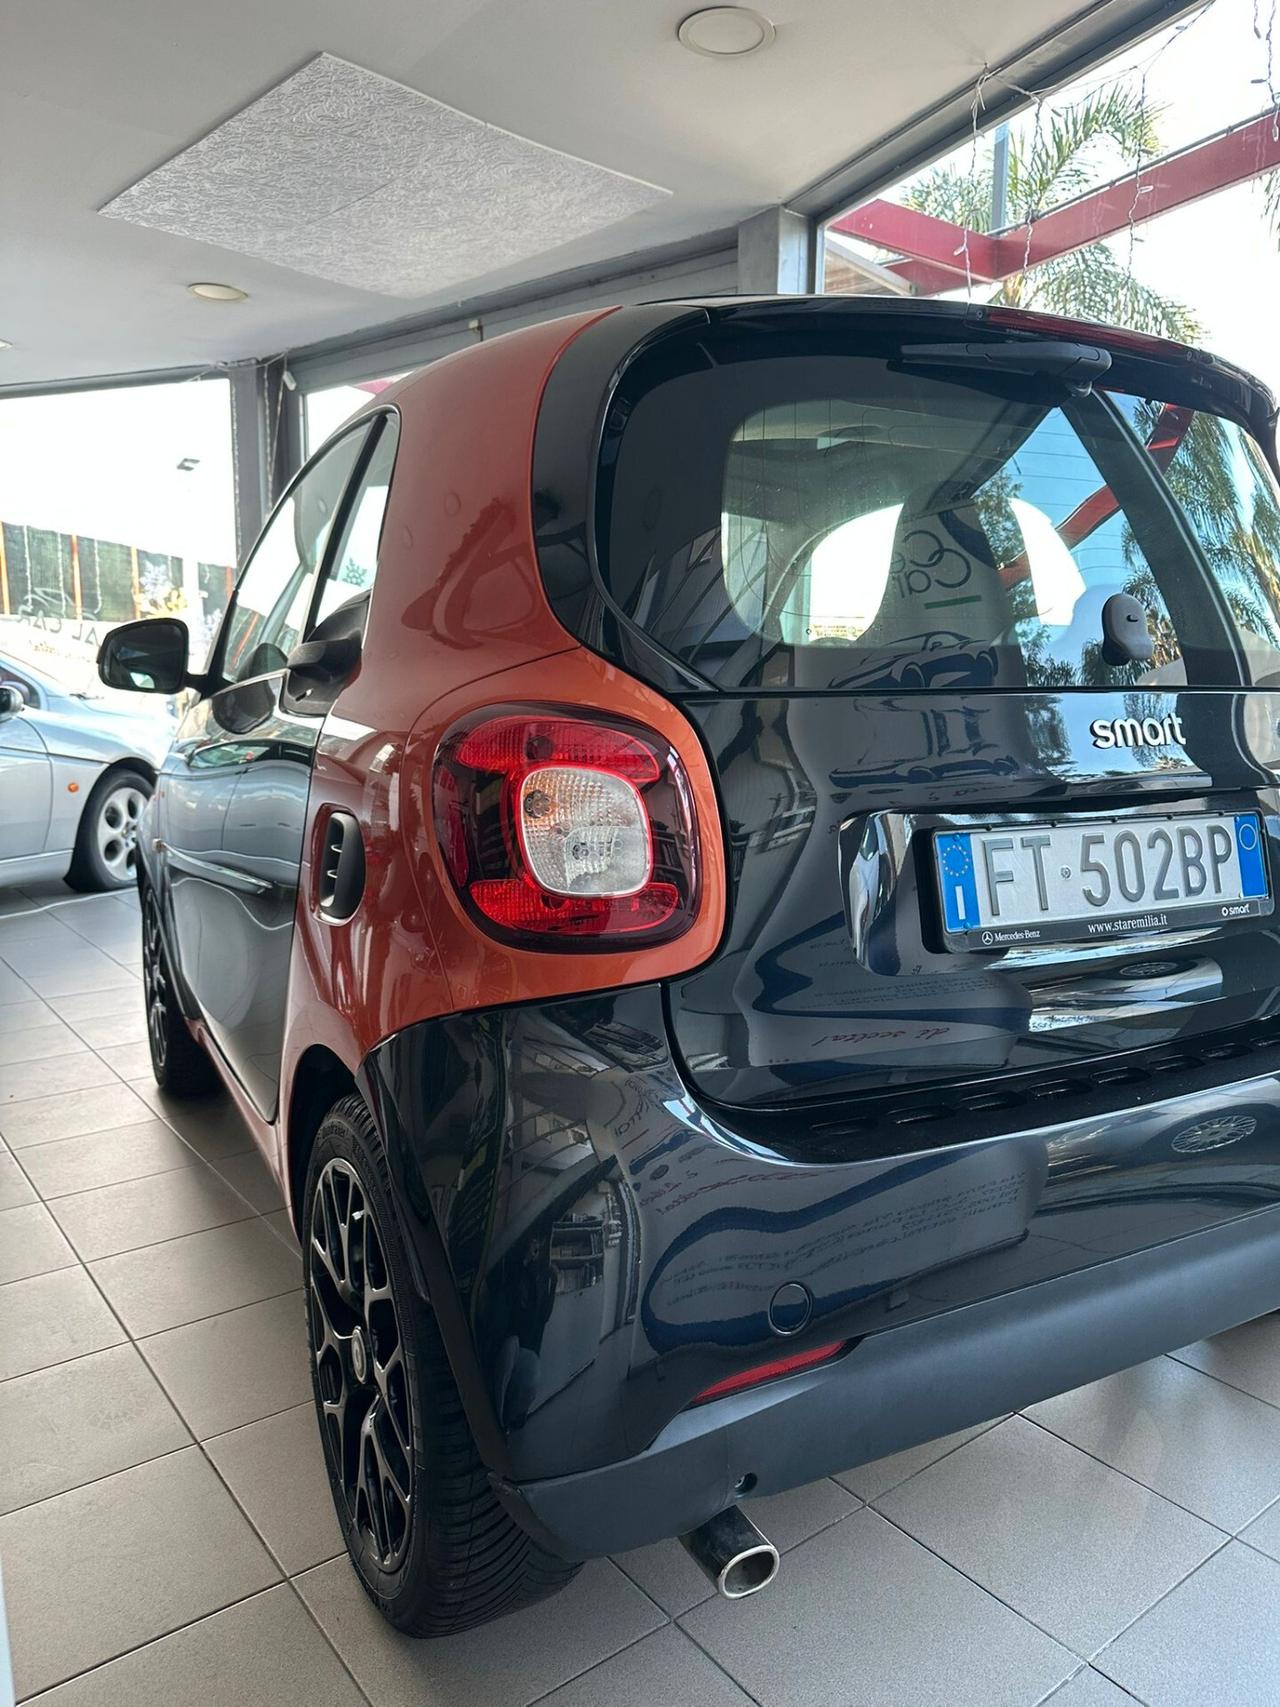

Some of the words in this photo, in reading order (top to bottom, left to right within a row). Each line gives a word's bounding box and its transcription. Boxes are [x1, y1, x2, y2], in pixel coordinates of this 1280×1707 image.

[1090, 713, 1187, 749] smart
[982, 834, 1052, 917] FT
[1080, 823, 1233, 907] 502BP
[1228, 903, 1250, 916] smart
[994, 929, 1041, 941] Mercedes-Benz
[1088, 914, 1168, 935] www.staremilia.it
